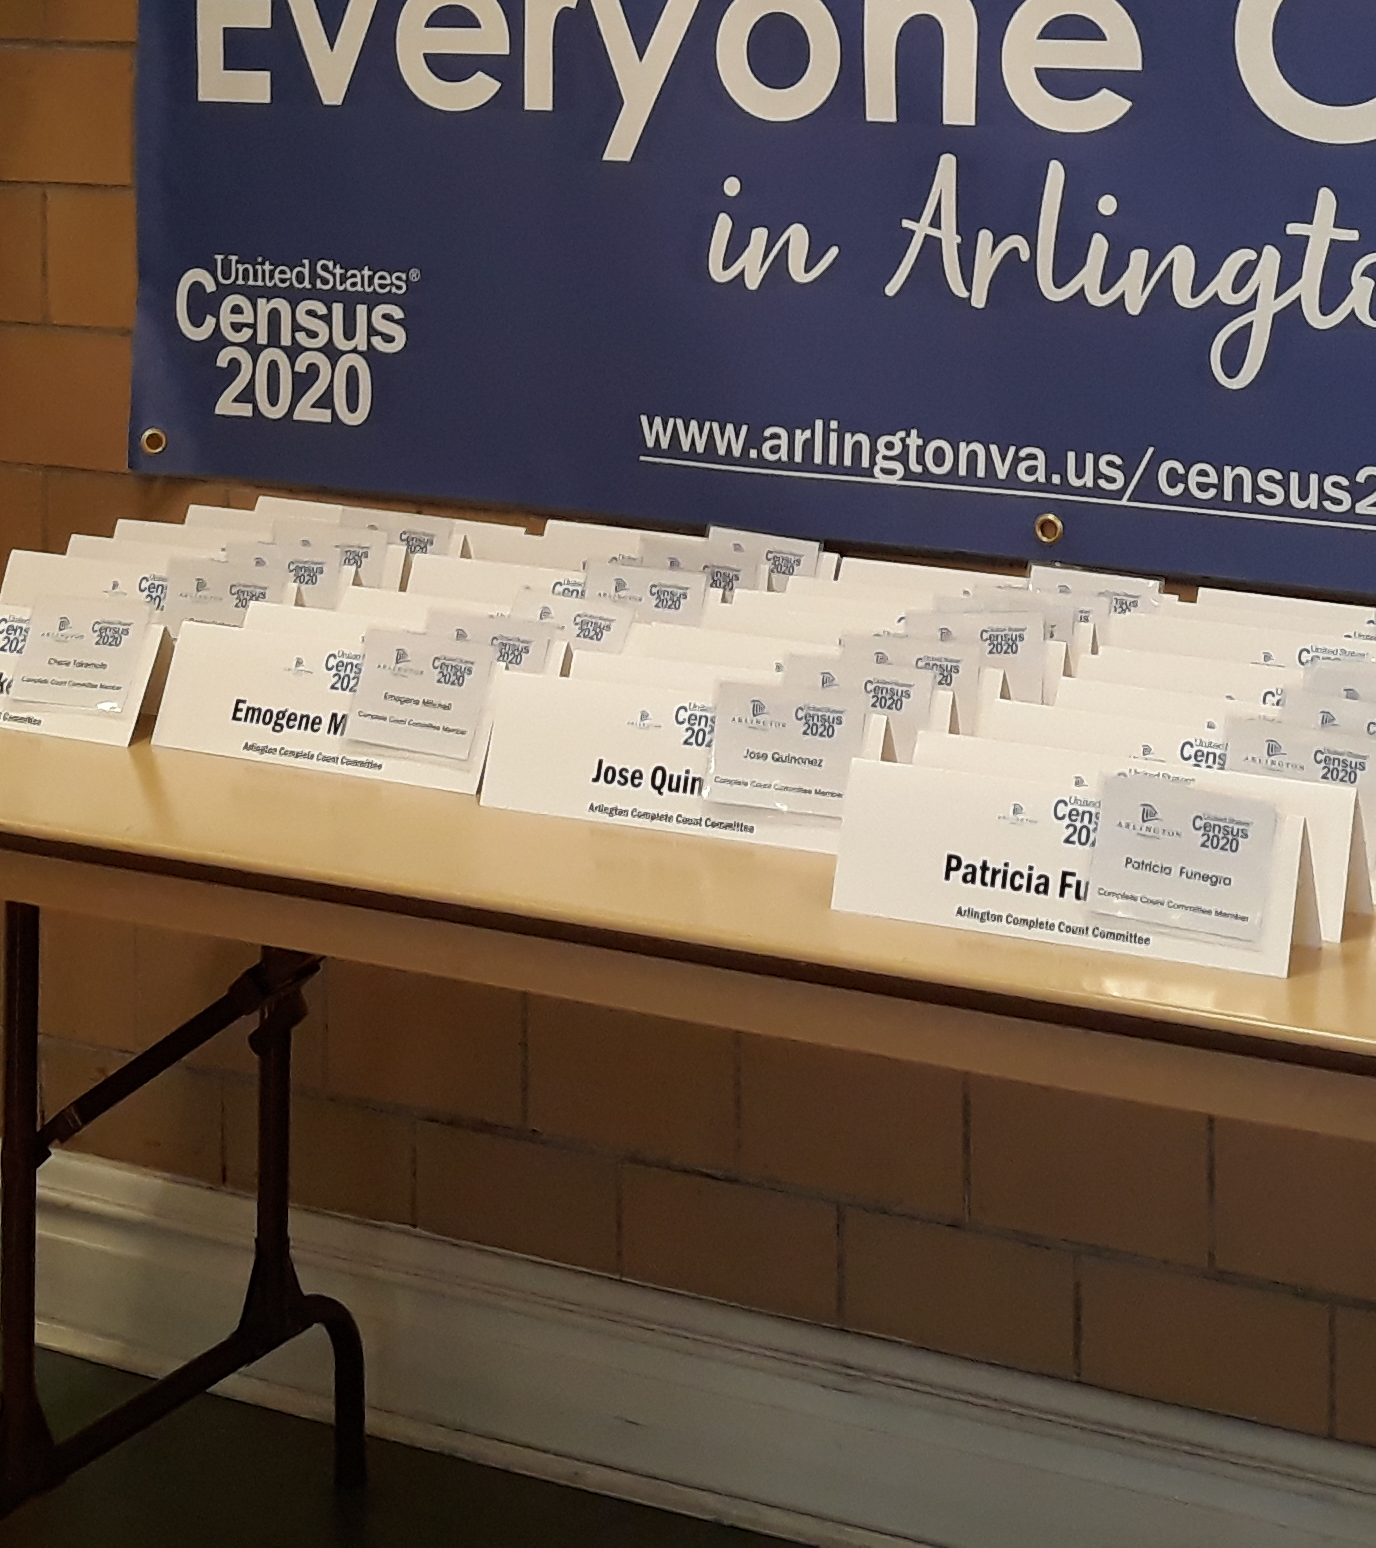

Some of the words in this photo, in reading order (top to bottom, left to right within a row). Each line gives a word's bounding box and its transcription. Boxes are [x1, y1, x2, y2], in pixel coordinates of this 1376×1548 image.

[708, 176, 840, 291] in
[214, 254, 312, 289] United
[176, 267, 407, 354] Census
[214, 346, 372, 426] 2020
[988, 641, 1018, 655] 2020
[231, 699, 323, 734] Emogene
[795, 706, 843, 726] Census
[870, 695, 903, 711] 2020
[802, 723, 835, 738] 2020
[1314, 749, 1366, 771] Census
[1320, 766, 1358, 784] 2020
[591, 758, 643, 788] Jose
[650, 766, 704, 796] Quin
[1192, 814, 1249, 839] Census
[1200, 832, 1239, 853] 2020
[944, 853, 1050, 897] Patricia
[1124, 856, 1172, 876] Patricia
[1179, 866, 1232, 888] Funegra
[955, 905, 1003, 925] Arlington
[1005, 914, 1055, 932] Complete
[1058, 922, 1090, 937] Count
[1092, 927, 1151, 946] Committee
